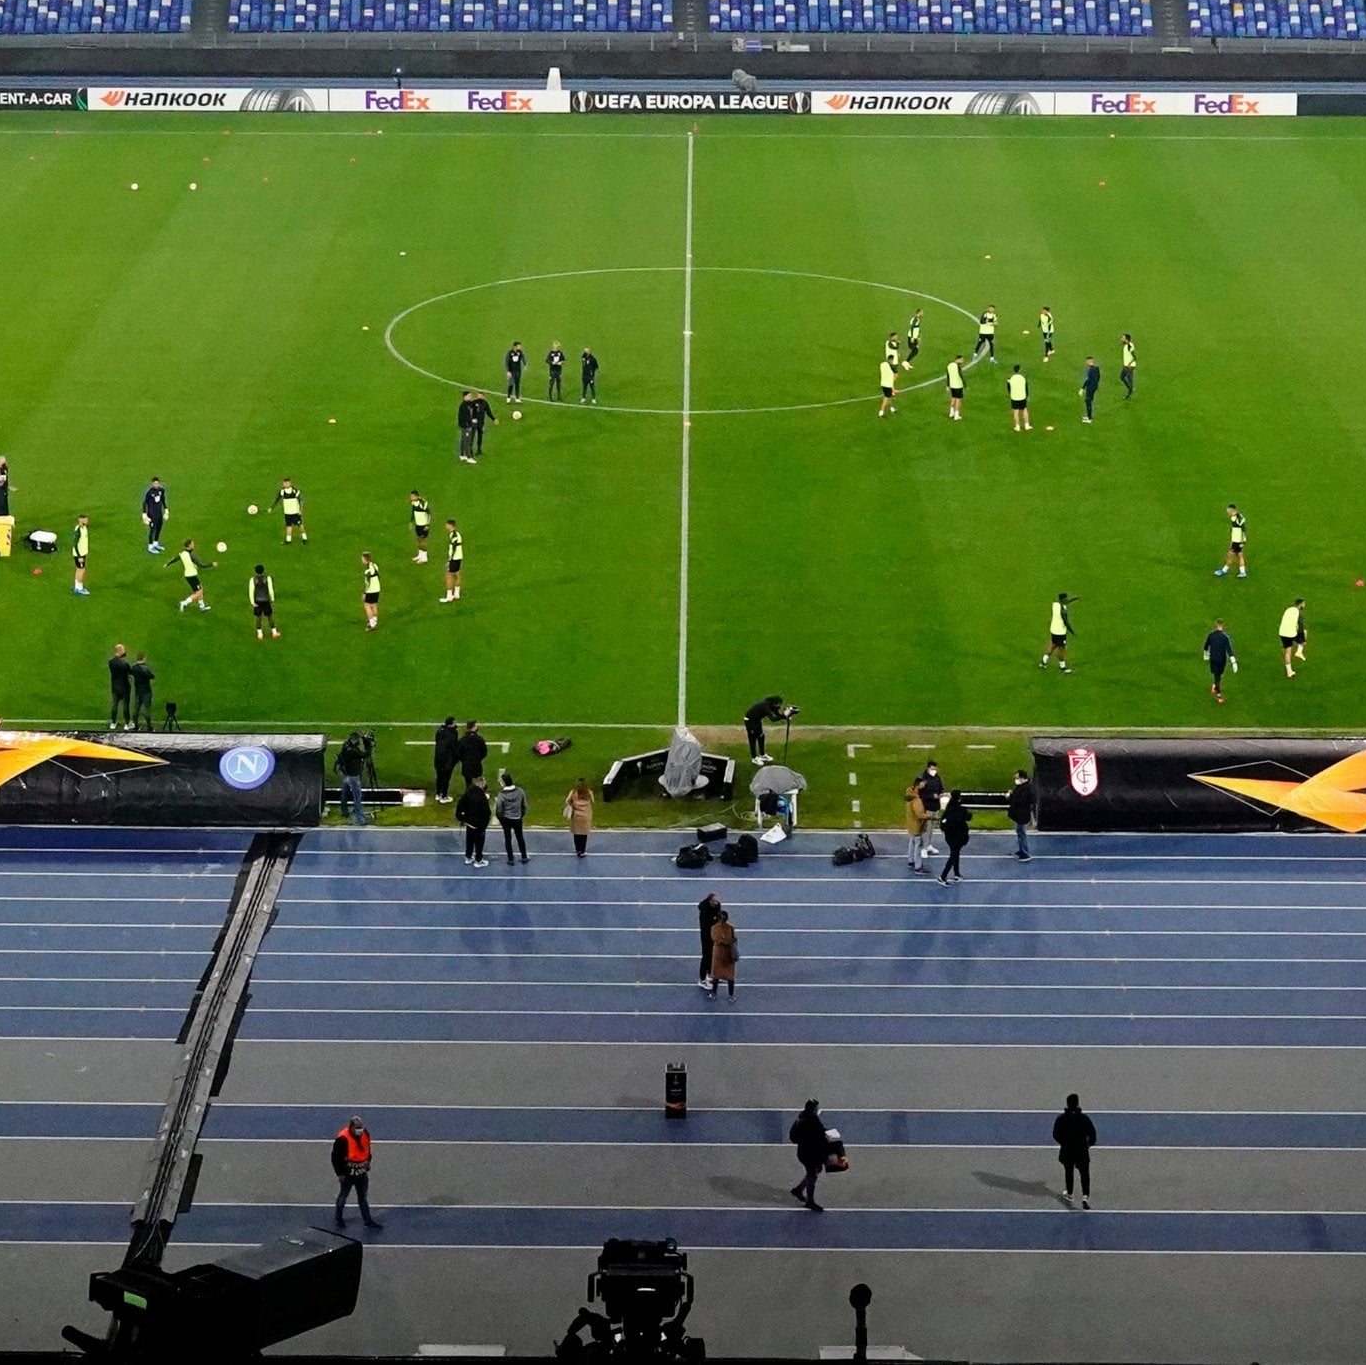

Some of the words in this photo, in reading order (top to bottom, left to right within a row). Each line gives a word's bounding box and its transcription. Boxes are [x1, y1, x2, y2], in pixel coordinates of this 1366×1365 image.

[365, 90, 431, 110] FedEx
[467, 91, 533, 111] FedEx
[594, 94, 641, 109] UEFA
[646, 94, 714, 110] EUROPA
[719, 95, 789, 110] LEAGUE
[1091, 93, 1156, 113] FedEx
[1194, 94, 1259, 114] FedEx
[234, 753, 260, 775] N
